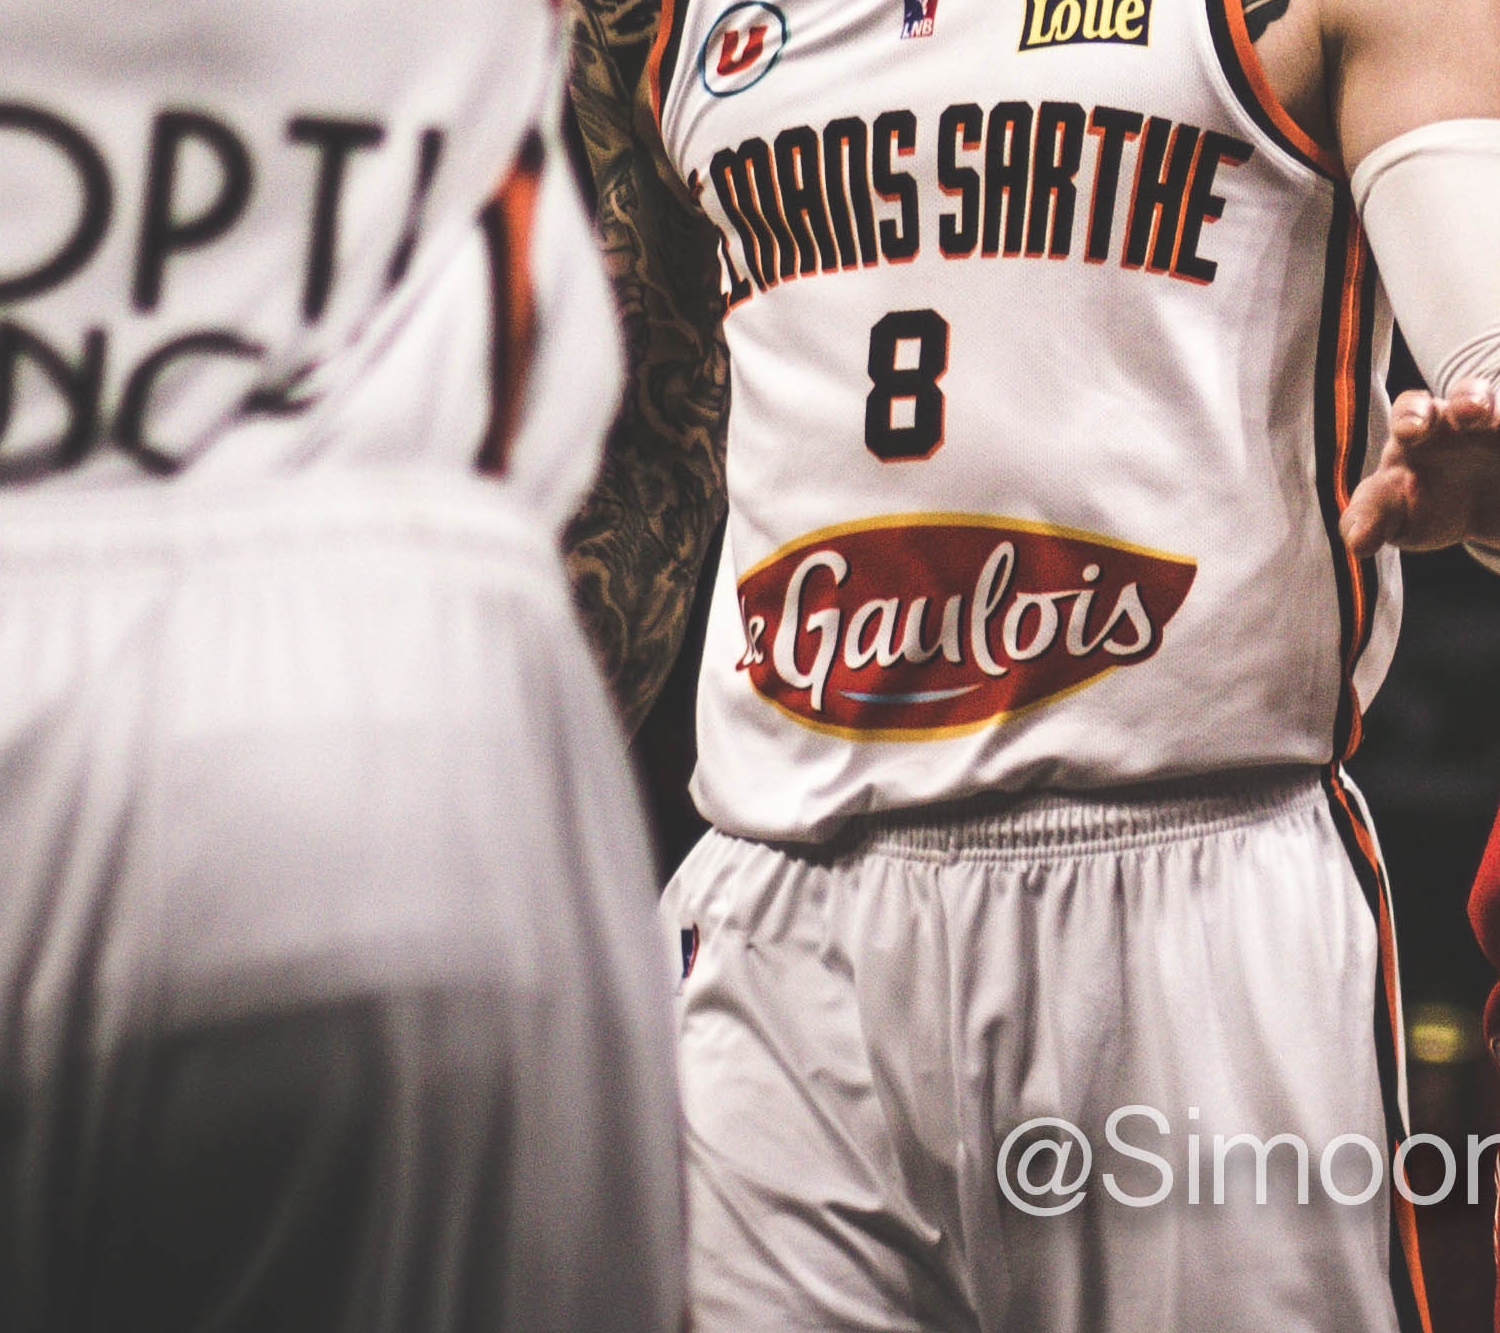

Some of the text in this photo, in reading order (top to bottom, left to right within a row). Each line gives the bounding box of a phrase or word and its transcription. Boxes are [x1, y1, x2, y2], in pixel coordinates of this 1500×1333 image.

[709, 109, 920, 294] MANS
[937, 101, 1255, 285] SARTHE
[865, 309, 949, 463] 8
[773, 540, 1153, 711] Gaulois
